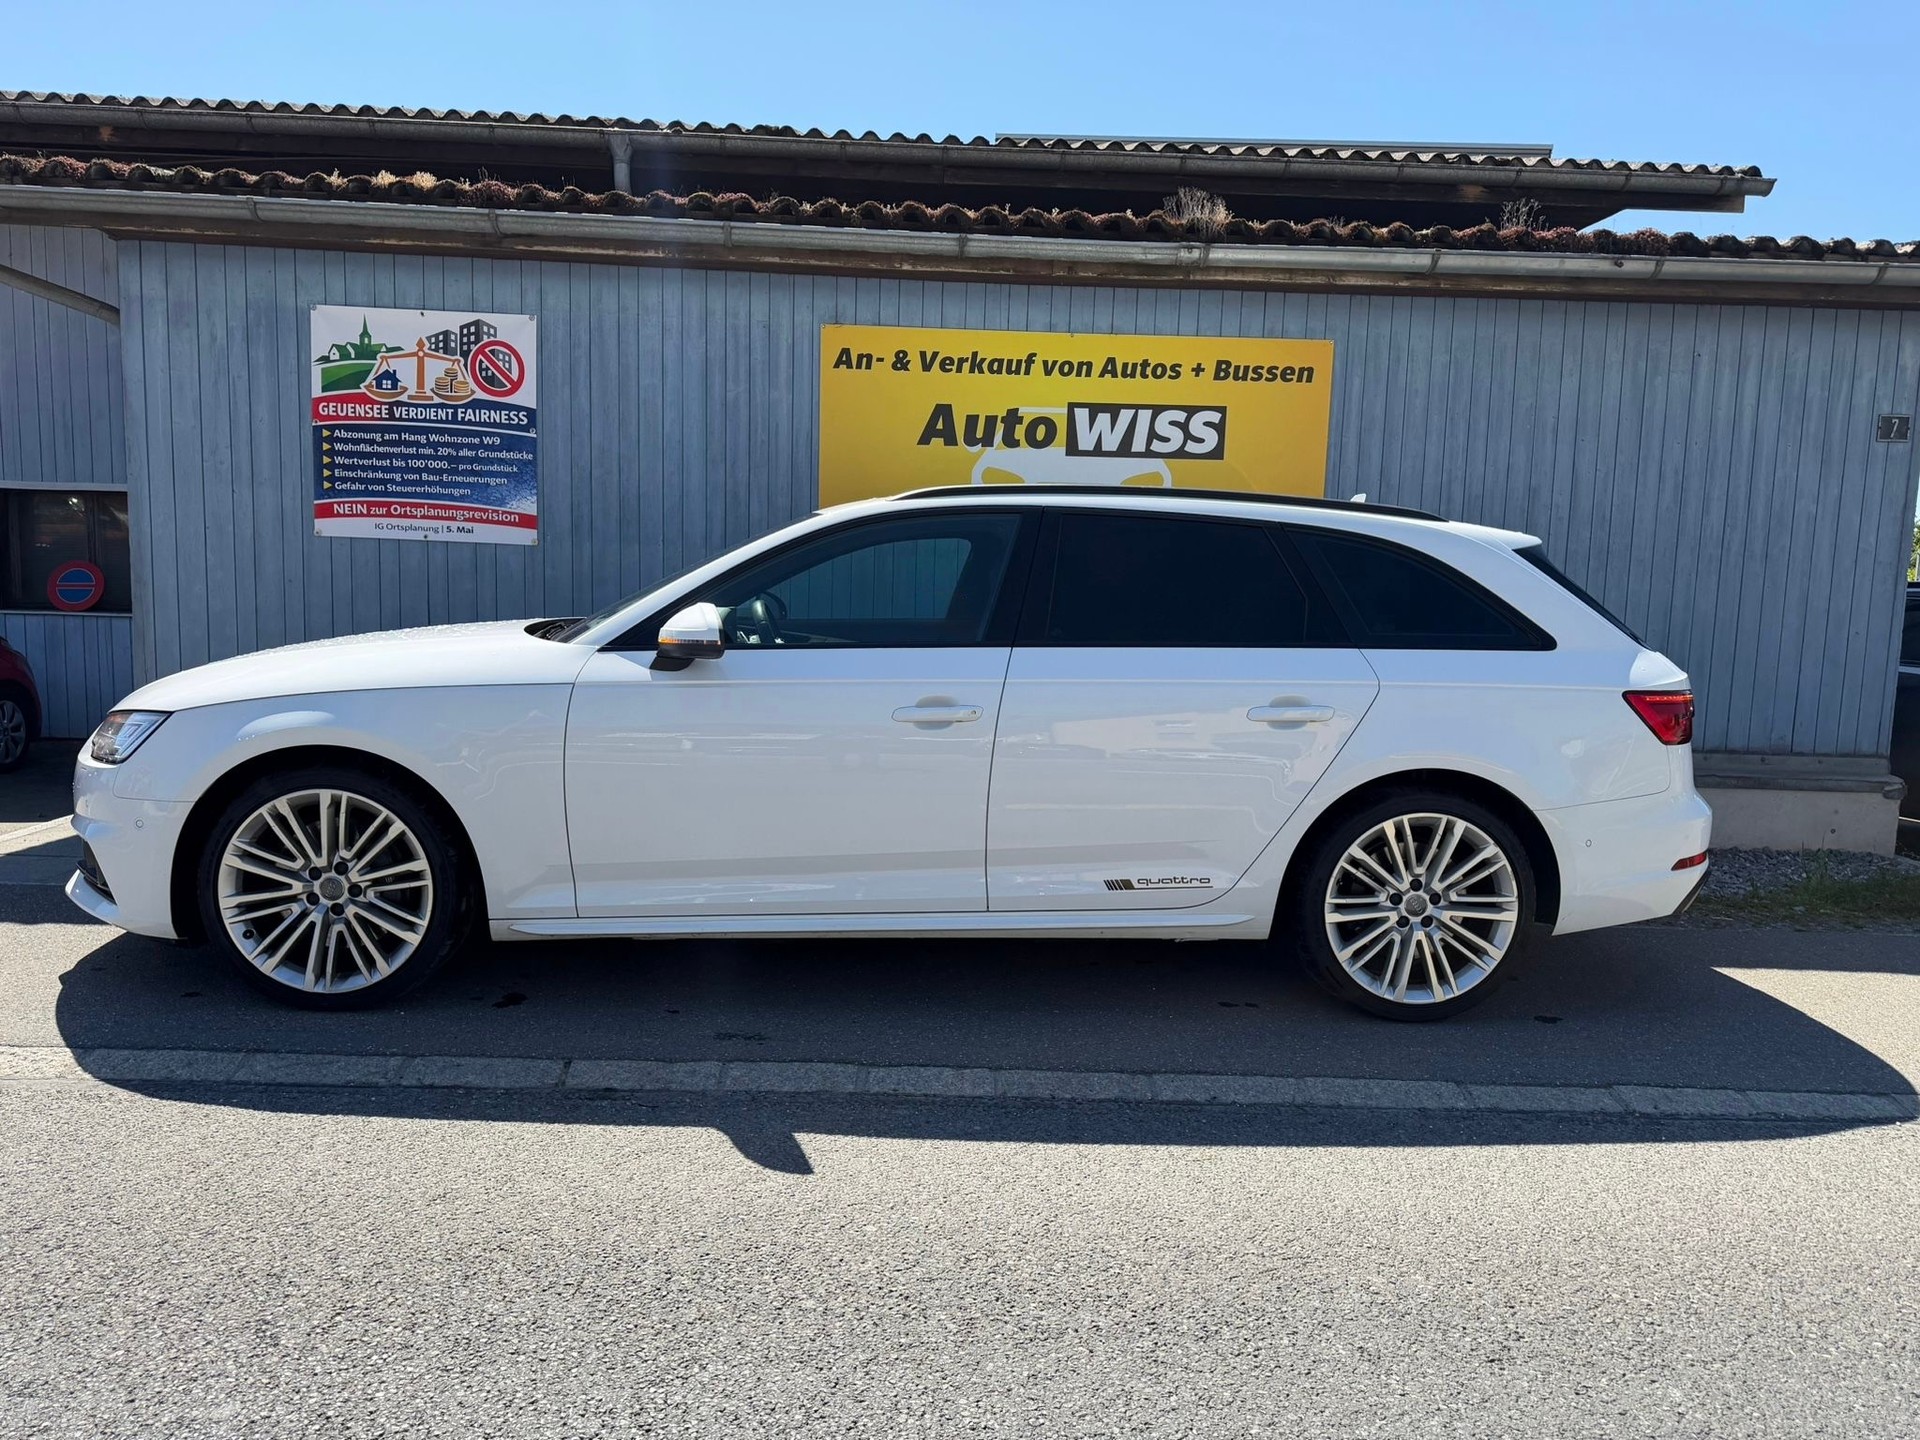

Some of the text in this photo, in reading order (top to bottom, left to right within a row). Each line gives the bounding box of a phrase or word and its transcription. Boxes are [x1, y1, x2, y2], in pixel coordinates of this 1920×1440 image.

[832, 347, 1314, 384] An- & Verkauf von Autos + Bussen
[318, 402, 528, 425] GEUENSEE VERDIENT FAIRNESS
[333, 429, 382, 442] Abzonung
[401, 432, 427, 444] Hang
[428, 433, 480, 444] Wohnzone
[482, 436, 501, 445] W9
[916, 403, 1223, 454] Auto WISS
[1890, 418, 1899, 438] 7
[333, 442, 533, 460] Wohnflächenverlust min. 20% aller Grundstücke
[334, 455, 391, 467] Wertverlust
[392, 459, 406, 467] bis
[472, 463, 519, 473] Grundstück
[334, 468, 508, 486] Einschränkung von Bau-Erneuerungen
[334, 481, 366, 492] Gefahr
[386, 483, 471, 497] Steuererhöhungen
[333, 503, 519, 522] NEIN zur Ortsplanungsrevision
[374, 522, 474, 534] IG Ortsplanung 5. Mai
[1137, 876, 1211, 887] quattro
